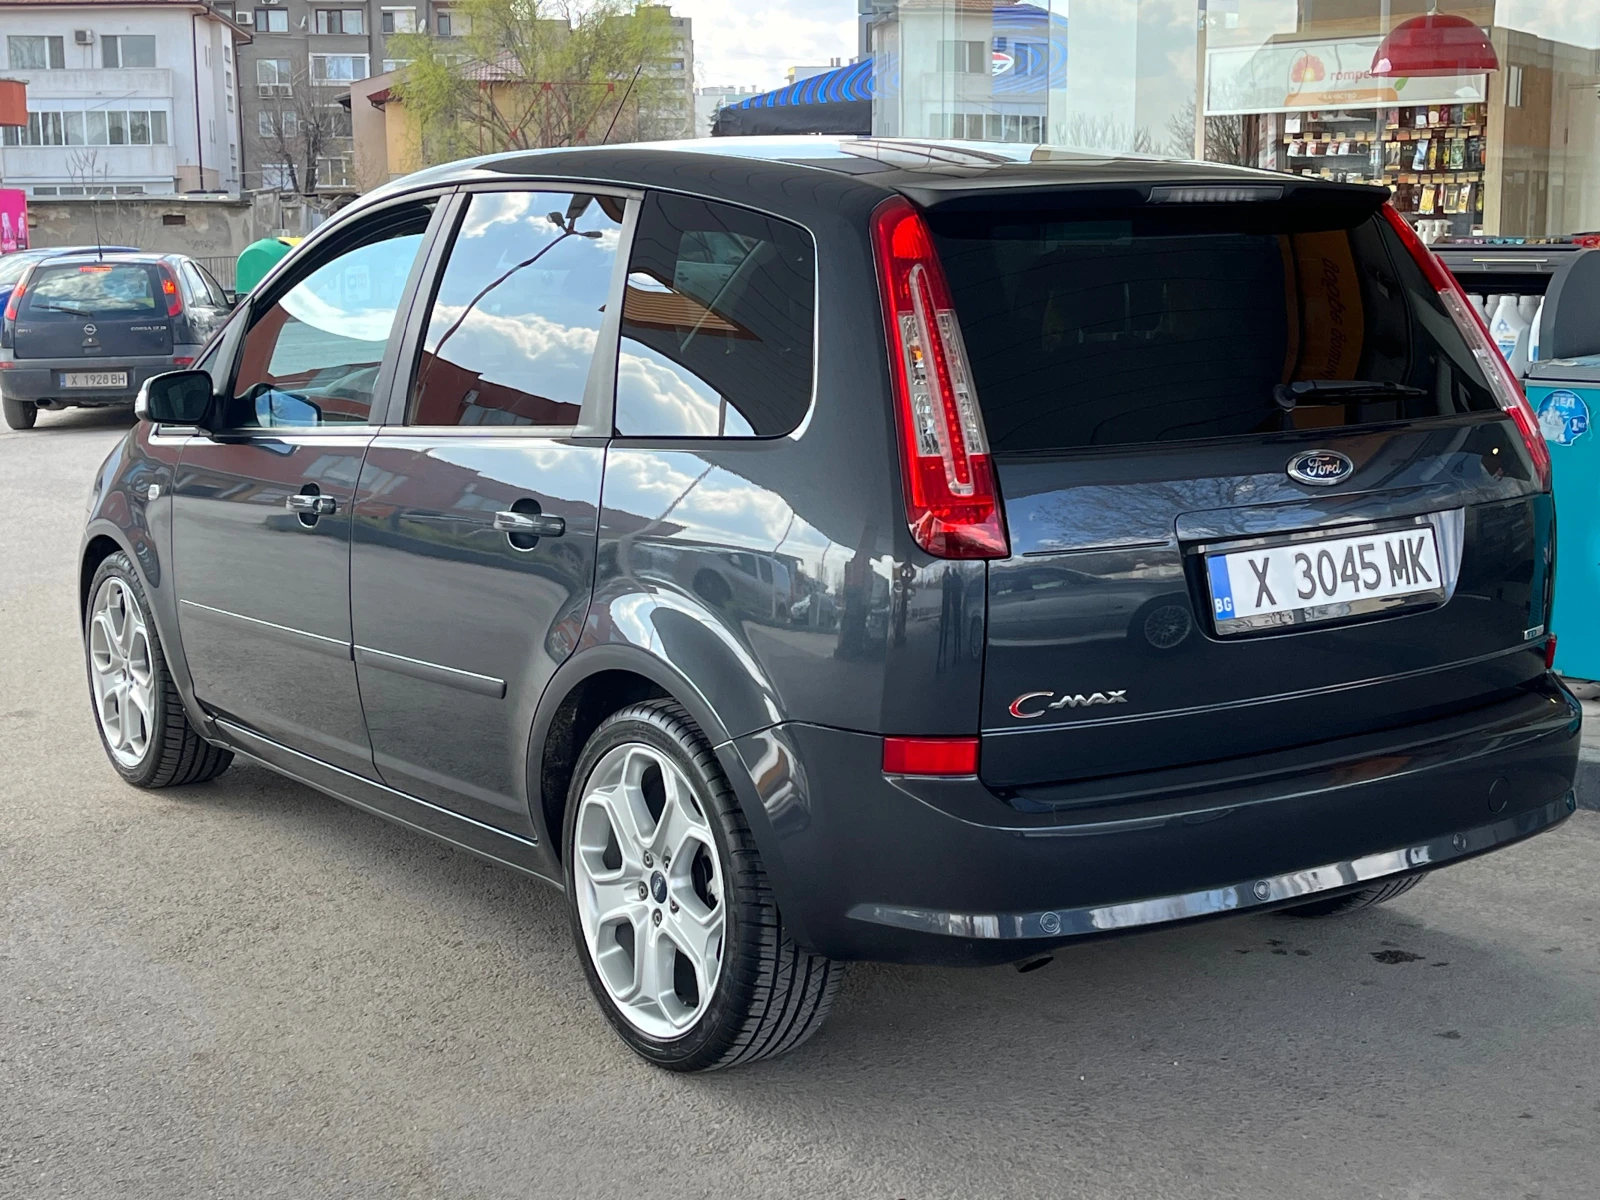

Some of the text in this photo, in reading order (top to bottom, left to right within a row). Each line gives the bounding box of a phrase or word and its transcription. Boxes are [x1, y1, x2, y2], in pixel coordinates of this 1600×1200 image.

[71, 374, 78, 386] X
[84, 374, 109, 386] 1928
[110, 373, 126, 385] BH
[1550, 396, 1576, 409] ЛЕД
[1306, 456, 1342, 476] Ford
[1247, 536, 1432, 608] X 3045 MK
[1214, 597, 1233, 613] BG
[1008, 690, 1128, 718] C-MAX
